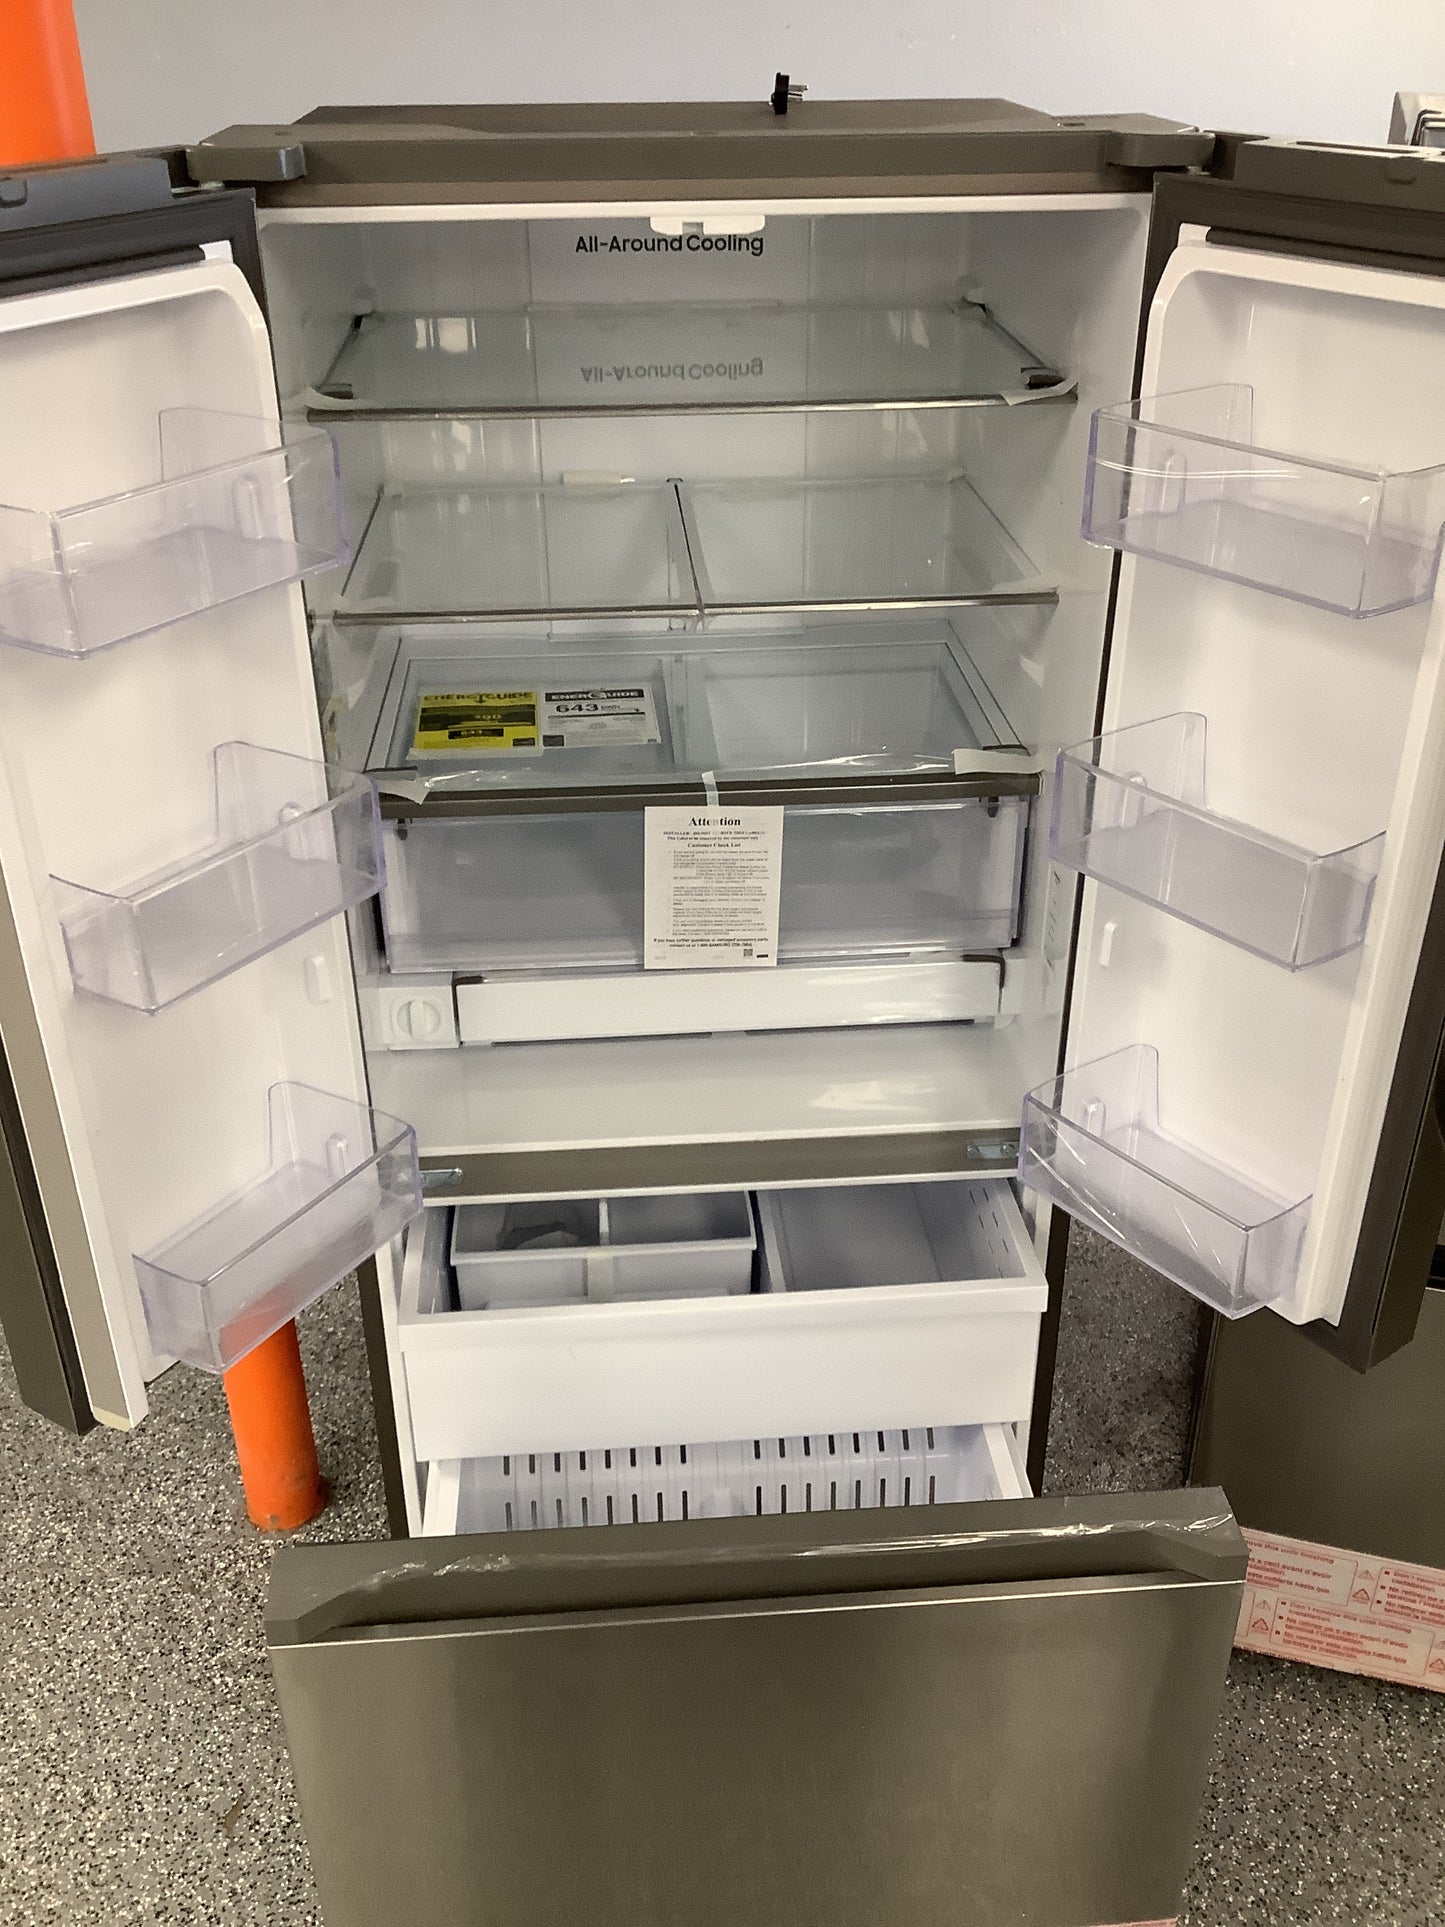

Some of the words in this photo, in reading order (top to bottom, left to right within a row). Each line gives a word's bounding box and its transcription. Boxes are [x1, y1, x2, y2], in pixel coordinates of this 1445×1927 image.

[575, 235, 682, 252] All-Around
[686, 234, 764, 257] Cooling
[556, 703, 598, 713] 643
